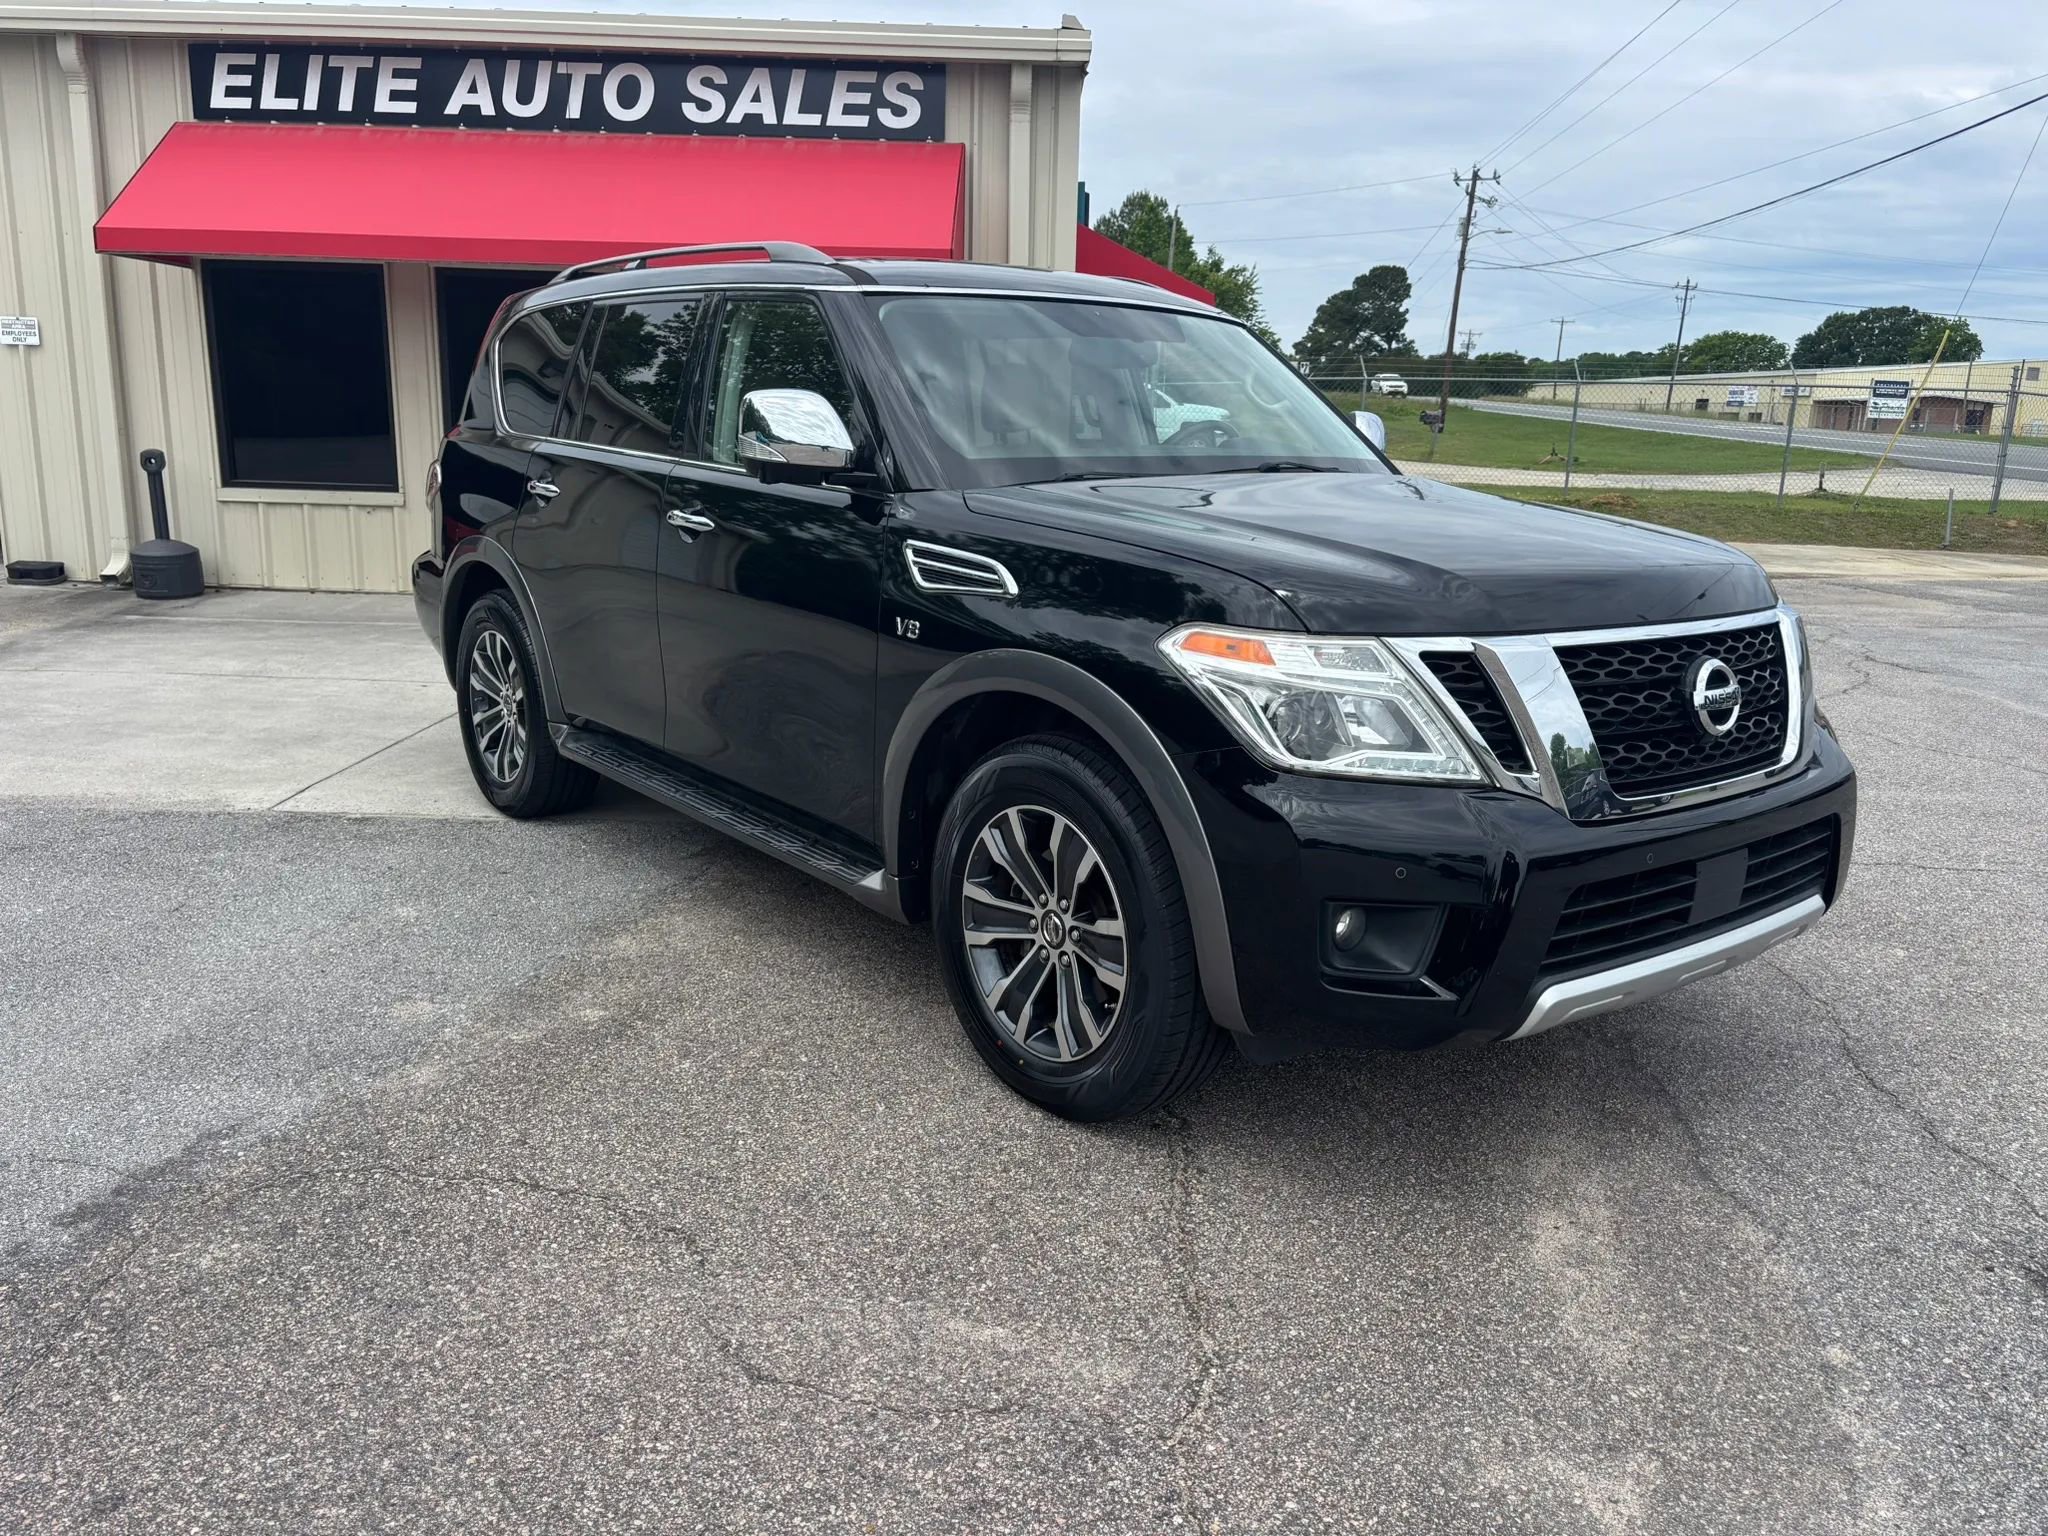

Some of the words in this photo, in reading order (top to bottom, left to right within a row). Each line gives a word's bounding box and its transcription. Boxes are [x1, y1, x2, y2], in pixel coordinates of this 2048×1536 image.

[209, 53, 421, 114] ELITE
[444, 59, 656, 122] AUTO
[681, 66, 924, 129] SALES
[896, 616, 921, 639] V8
